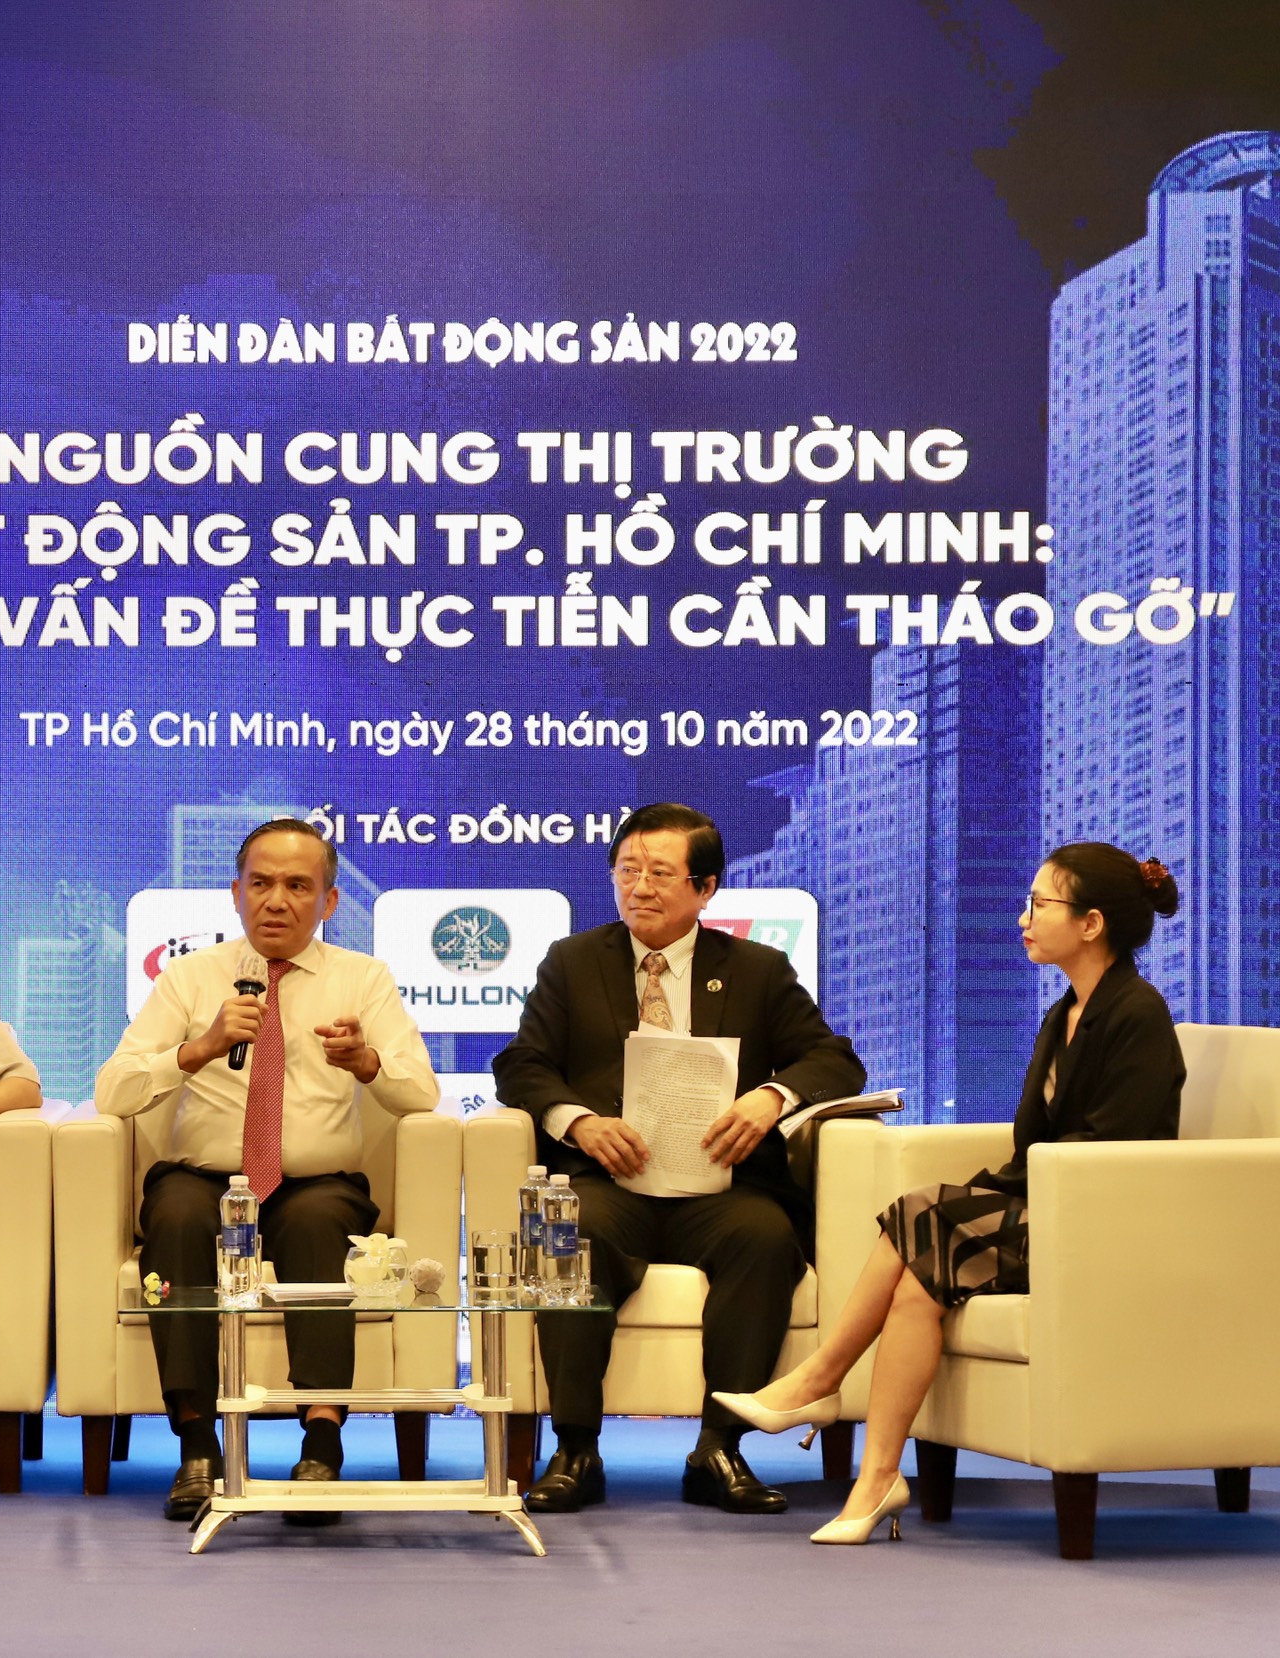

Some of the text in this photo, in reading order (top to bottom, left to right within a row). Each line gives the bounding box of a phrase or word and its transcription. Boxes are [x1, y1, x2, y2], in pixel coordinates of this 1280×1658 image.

[128, 312, 798, 368] DIỄN ĐÀN BẤT ĐỘNG SẢN 2022
[284, 431, 500, 485] CUNG
[517, 431, 632, 499] THỊ
[651, 416, 968, 484] TRƯỜNG
[24, 501, 251, 582] ĐỘNG
[269, 498, 416, 566] SẢN
[435, 514, 544, 566] TP.
[566, 493, 675, 566] HỒ
[694, 499, 826, 566] CHÍ
[844, 511, 1055, 565] MINH:
[161, 577, 260, 647] ĐỀ
[275, 591, 474, 663] THỰC
[492, 571, 649, 647] TIỄN
[669, 576, 826, 647] CẦN
[845, 580, 1054, 646] THÁO
[19, 709, 918, 757] TP Hồ Chí Minh, ngày 28 tháng 10 năm 2022
[272, 803, 345, 843] ỐI
[357, 806, 436, 844] TÁC
[448, 803, 574, 844] ĐỒNG
[398, 986, 535, 1006] PHULON
